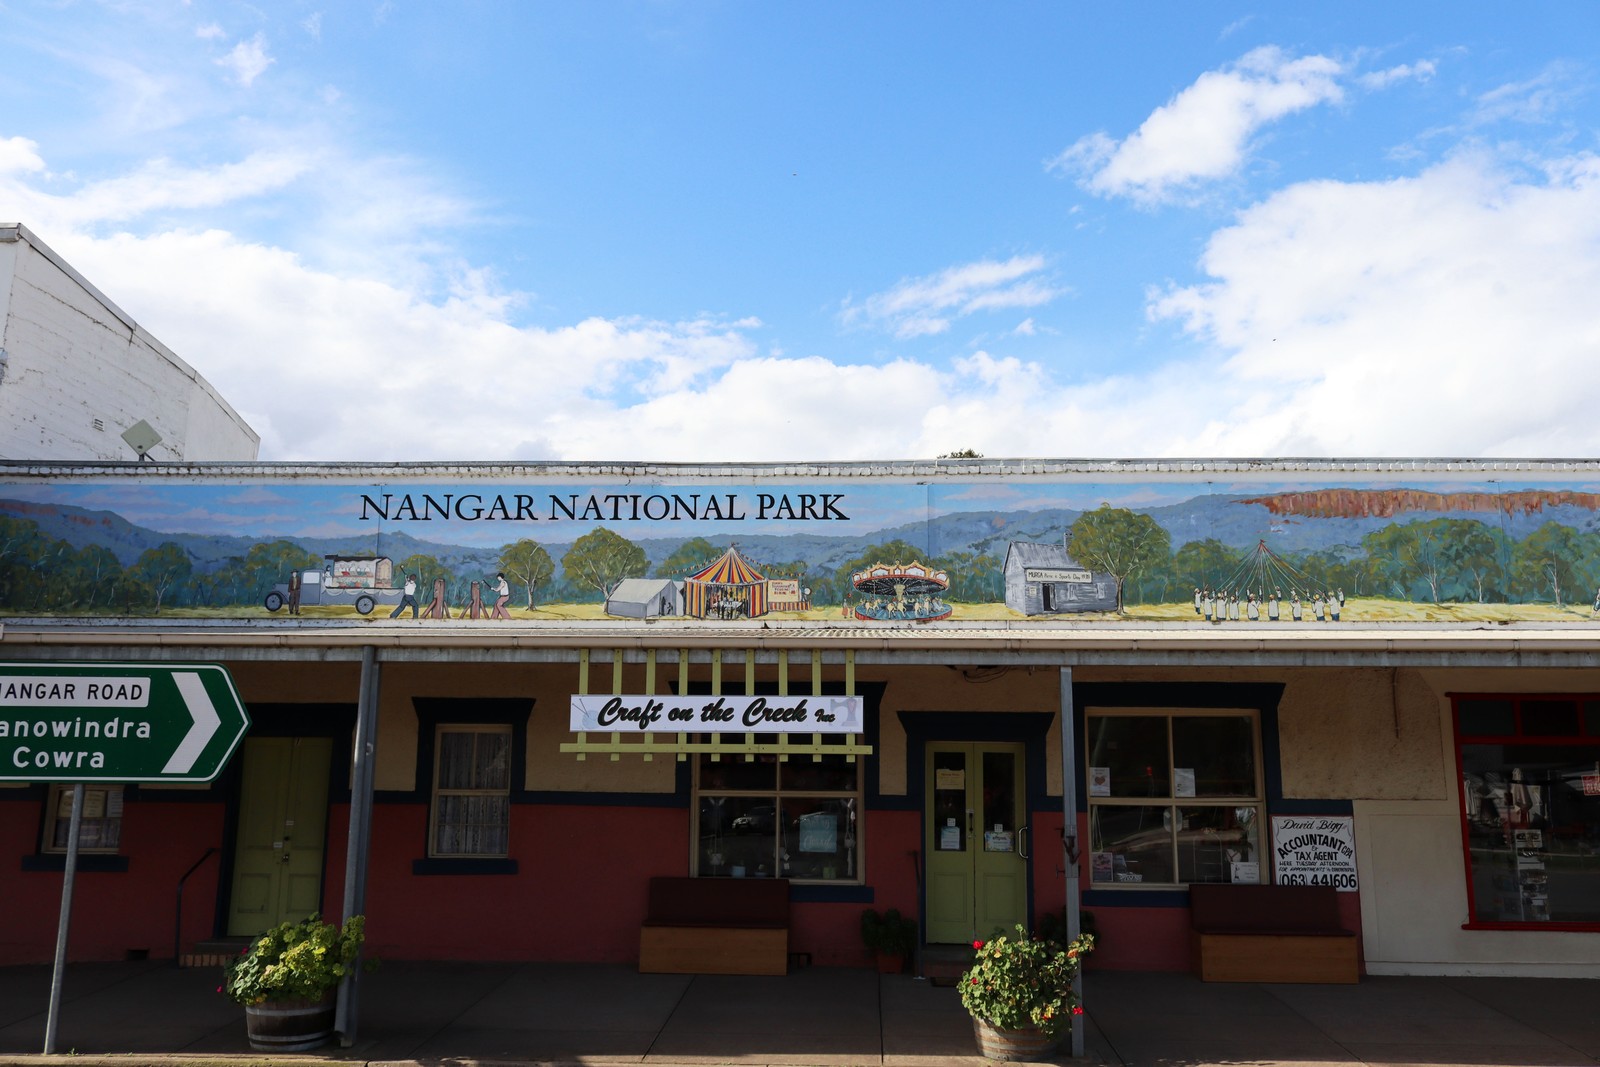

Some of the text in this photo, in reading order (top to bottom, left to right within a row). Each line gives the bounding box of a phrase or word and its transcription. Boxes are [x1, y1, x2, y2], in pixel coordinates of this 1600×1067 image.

[359, 493, 850, 521] NANGAR NATIONAL PARK
[0, 683, 143, 700] ANGAR ROAD
[597, 697, 664, 730] Craft
[668, 705, 694, 722] on
[700, 698, 735, 722] the
[742, 697, 808, 727] Creek
[13, 746, 105, 768] Cowra
[1280, 819, 1315, 830] David
[1277, 834, 1354, 859] ACCOUNTANT CPA
[1294, 852, 1338, 861] TAX AGENT
[1279, 874, 1308, 886] (063)
